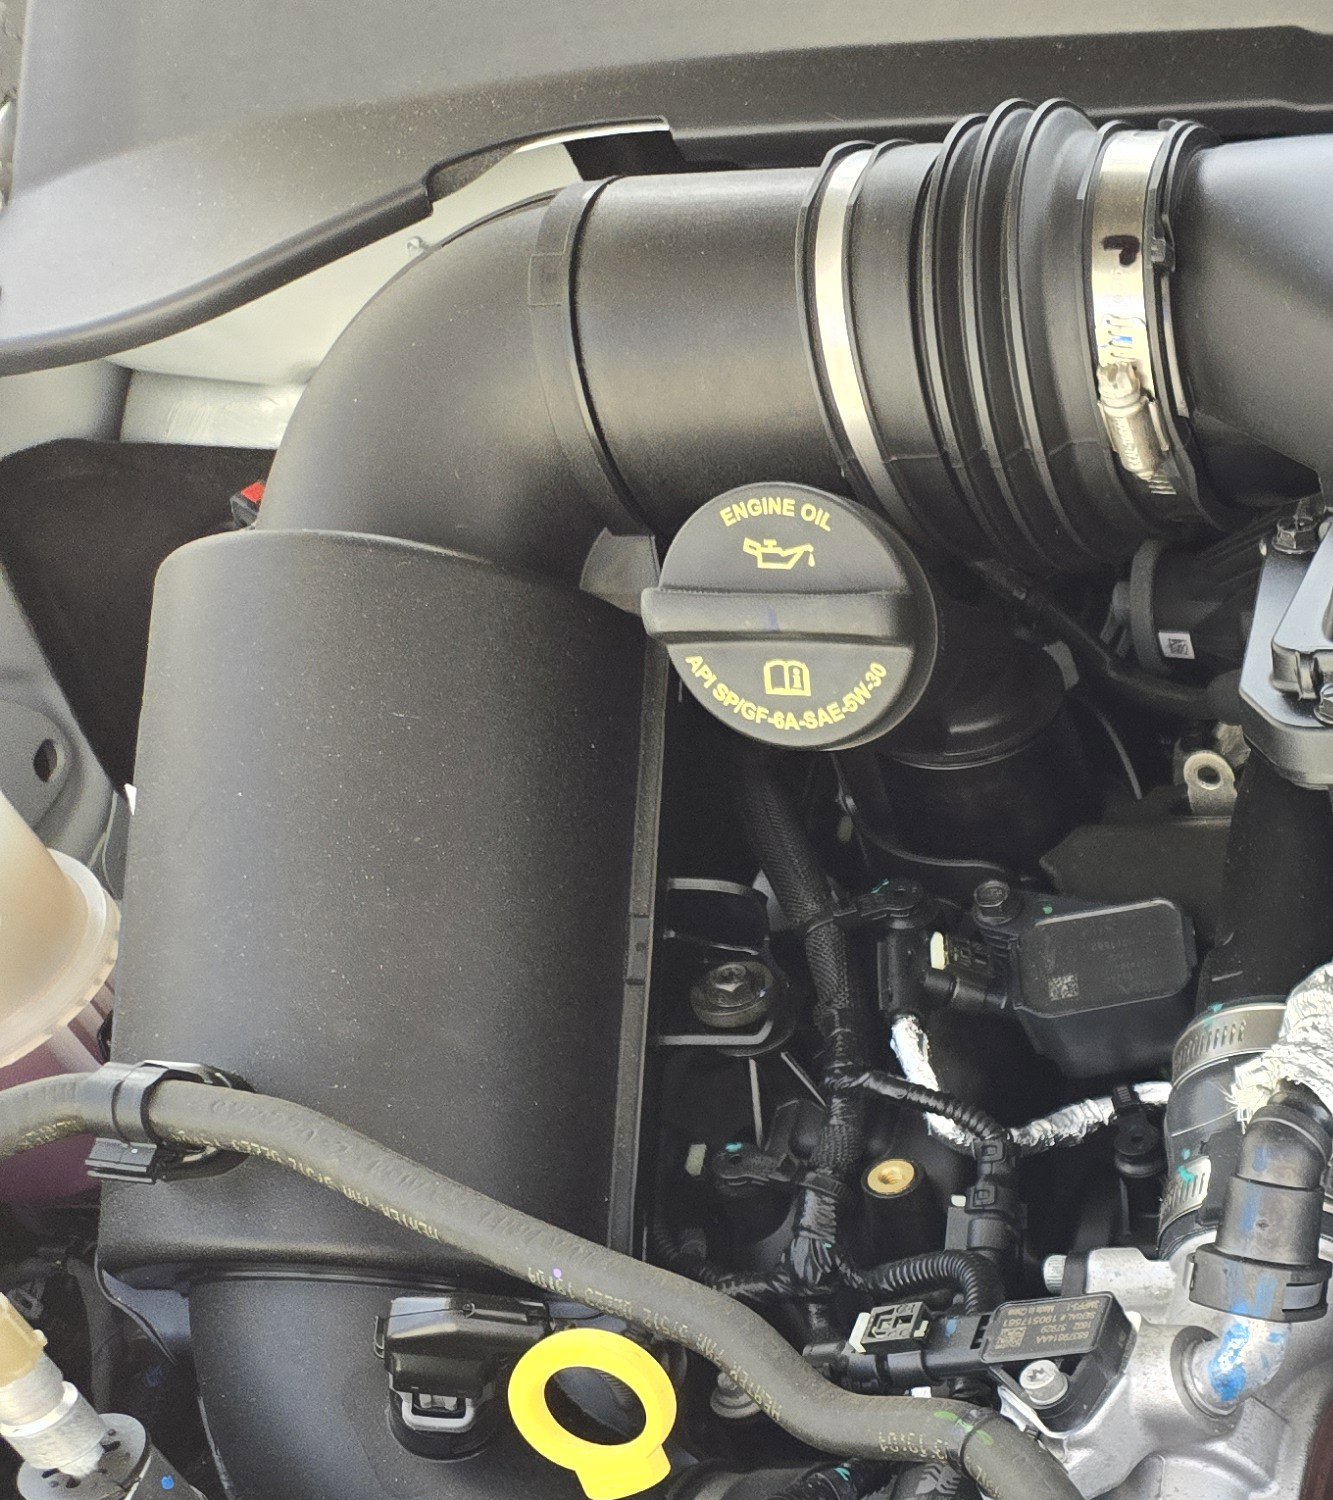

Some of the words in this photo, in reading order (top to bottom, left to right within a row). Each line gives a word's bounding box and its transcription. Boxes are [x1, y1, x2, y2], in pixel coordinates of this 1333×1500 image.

[719, 496, 796, 528] ENGINE
[800, 503, 832, 532] OIL
[684, 654, 719, 690] API
